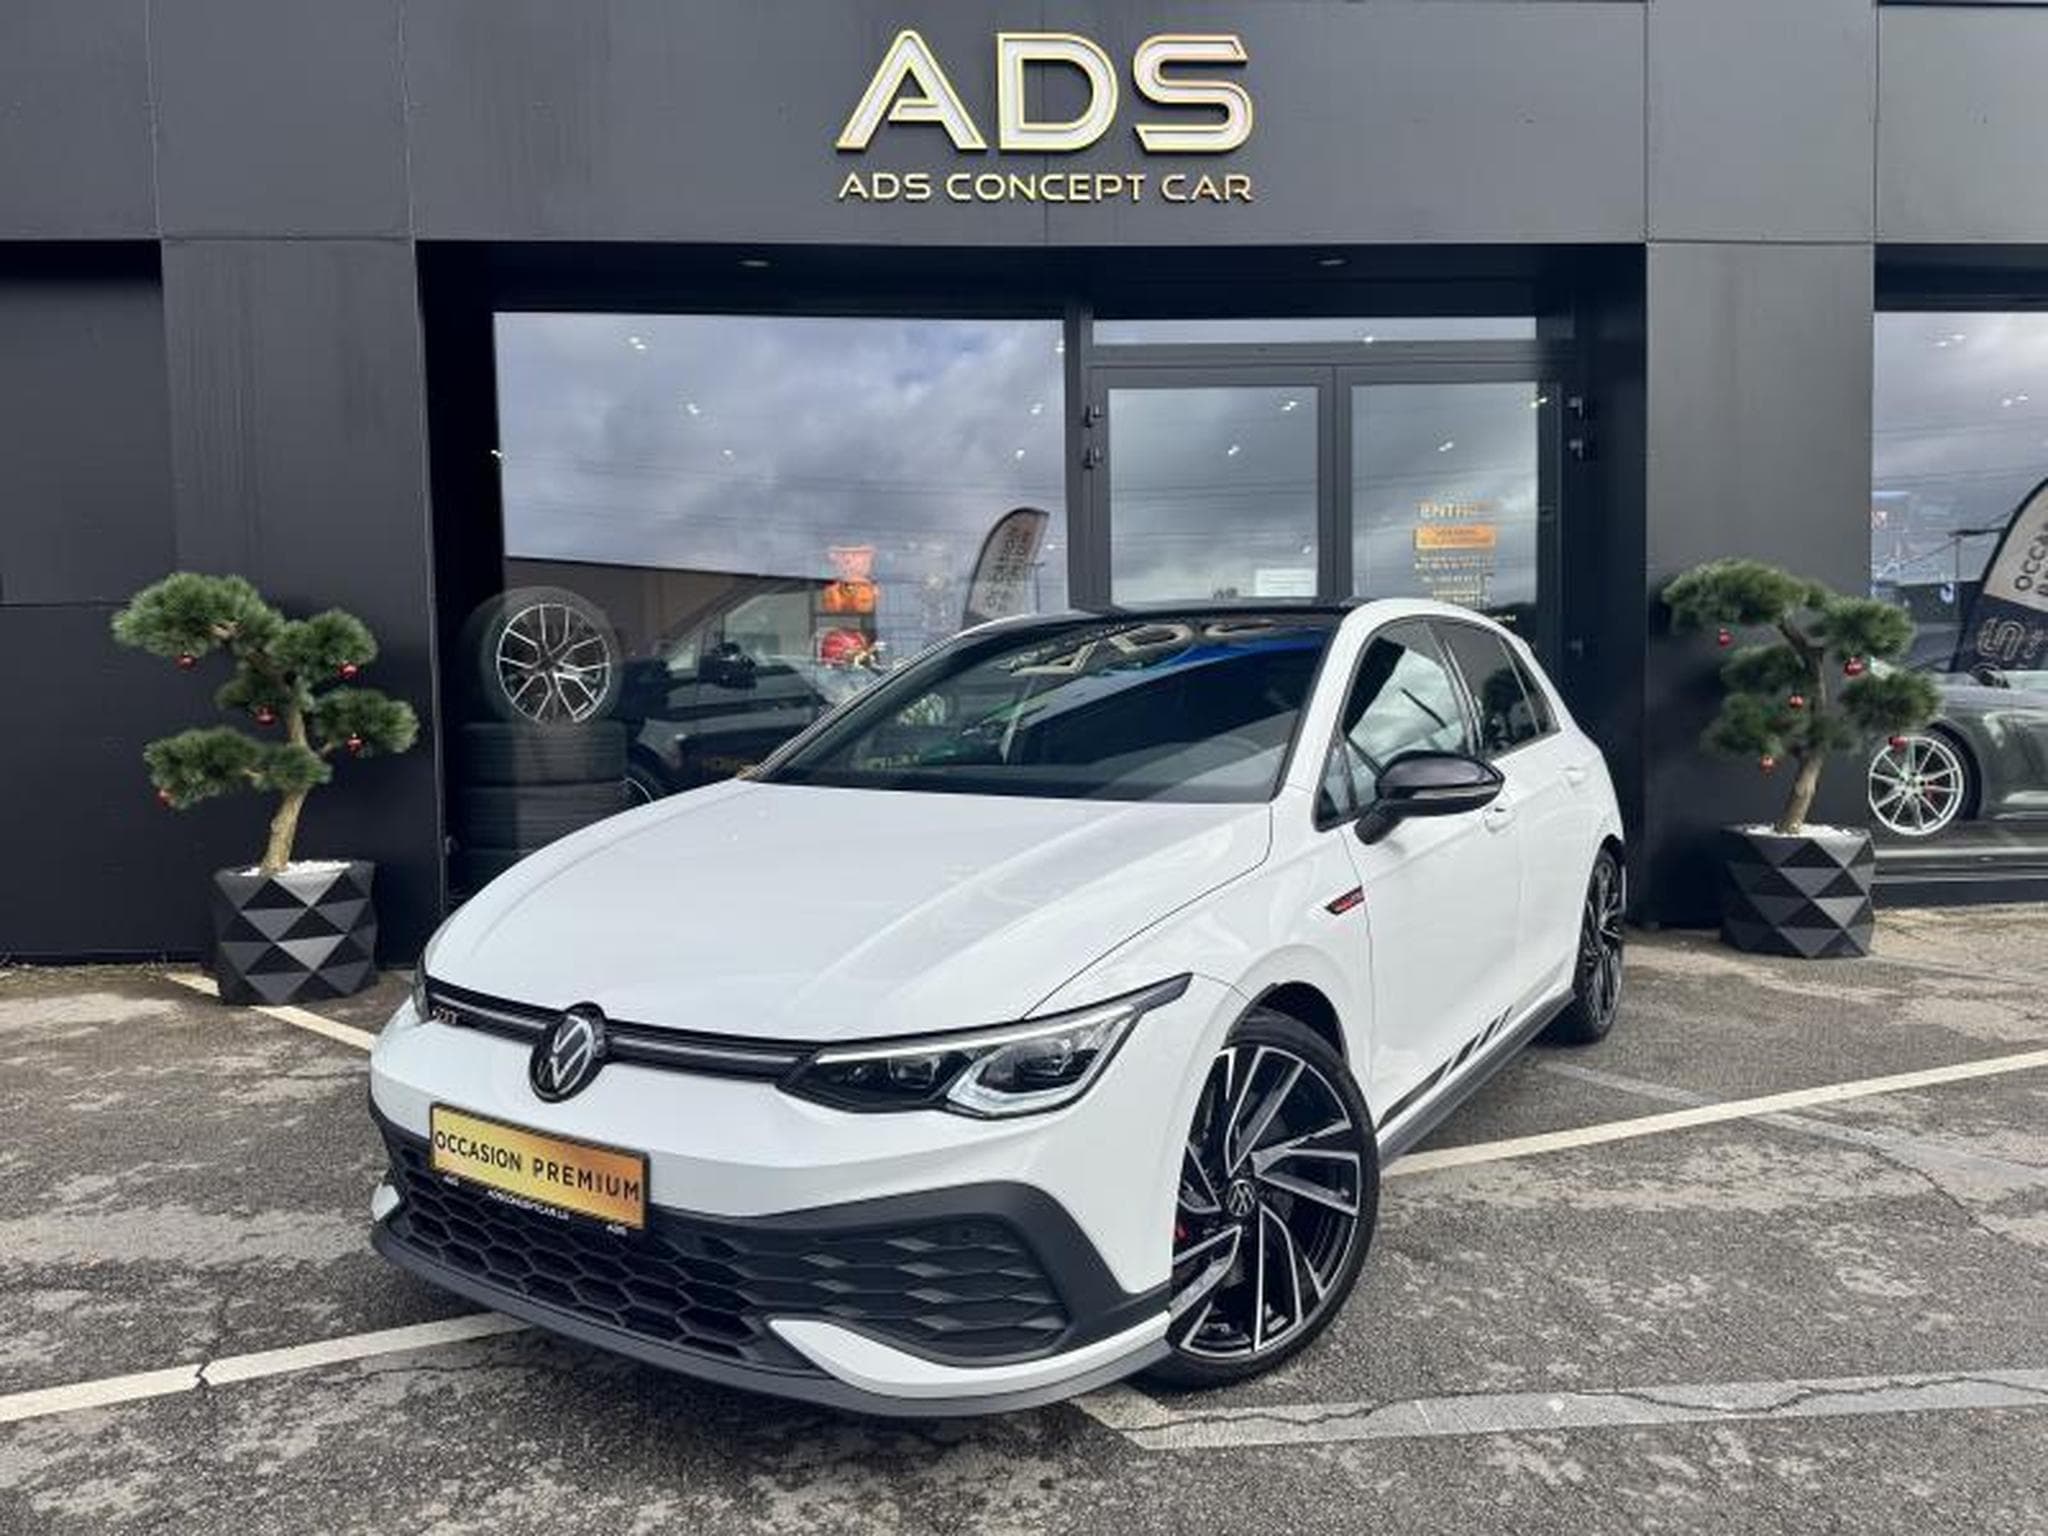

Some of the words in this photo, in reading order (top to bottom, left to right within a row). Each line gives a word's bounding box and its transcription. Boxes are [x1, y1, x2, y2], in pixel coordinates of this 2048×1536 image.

[836, 29, 1254, 153] ADS
[838, 172, 931, 201] ADS
[945, 173, 1147, 201] CONCEPT
[1160, 174, 1254, 201] CAR
[434, 1130, 522, 1171] OCCASION
[532, 1157, 640, 1202] PREMIUM
